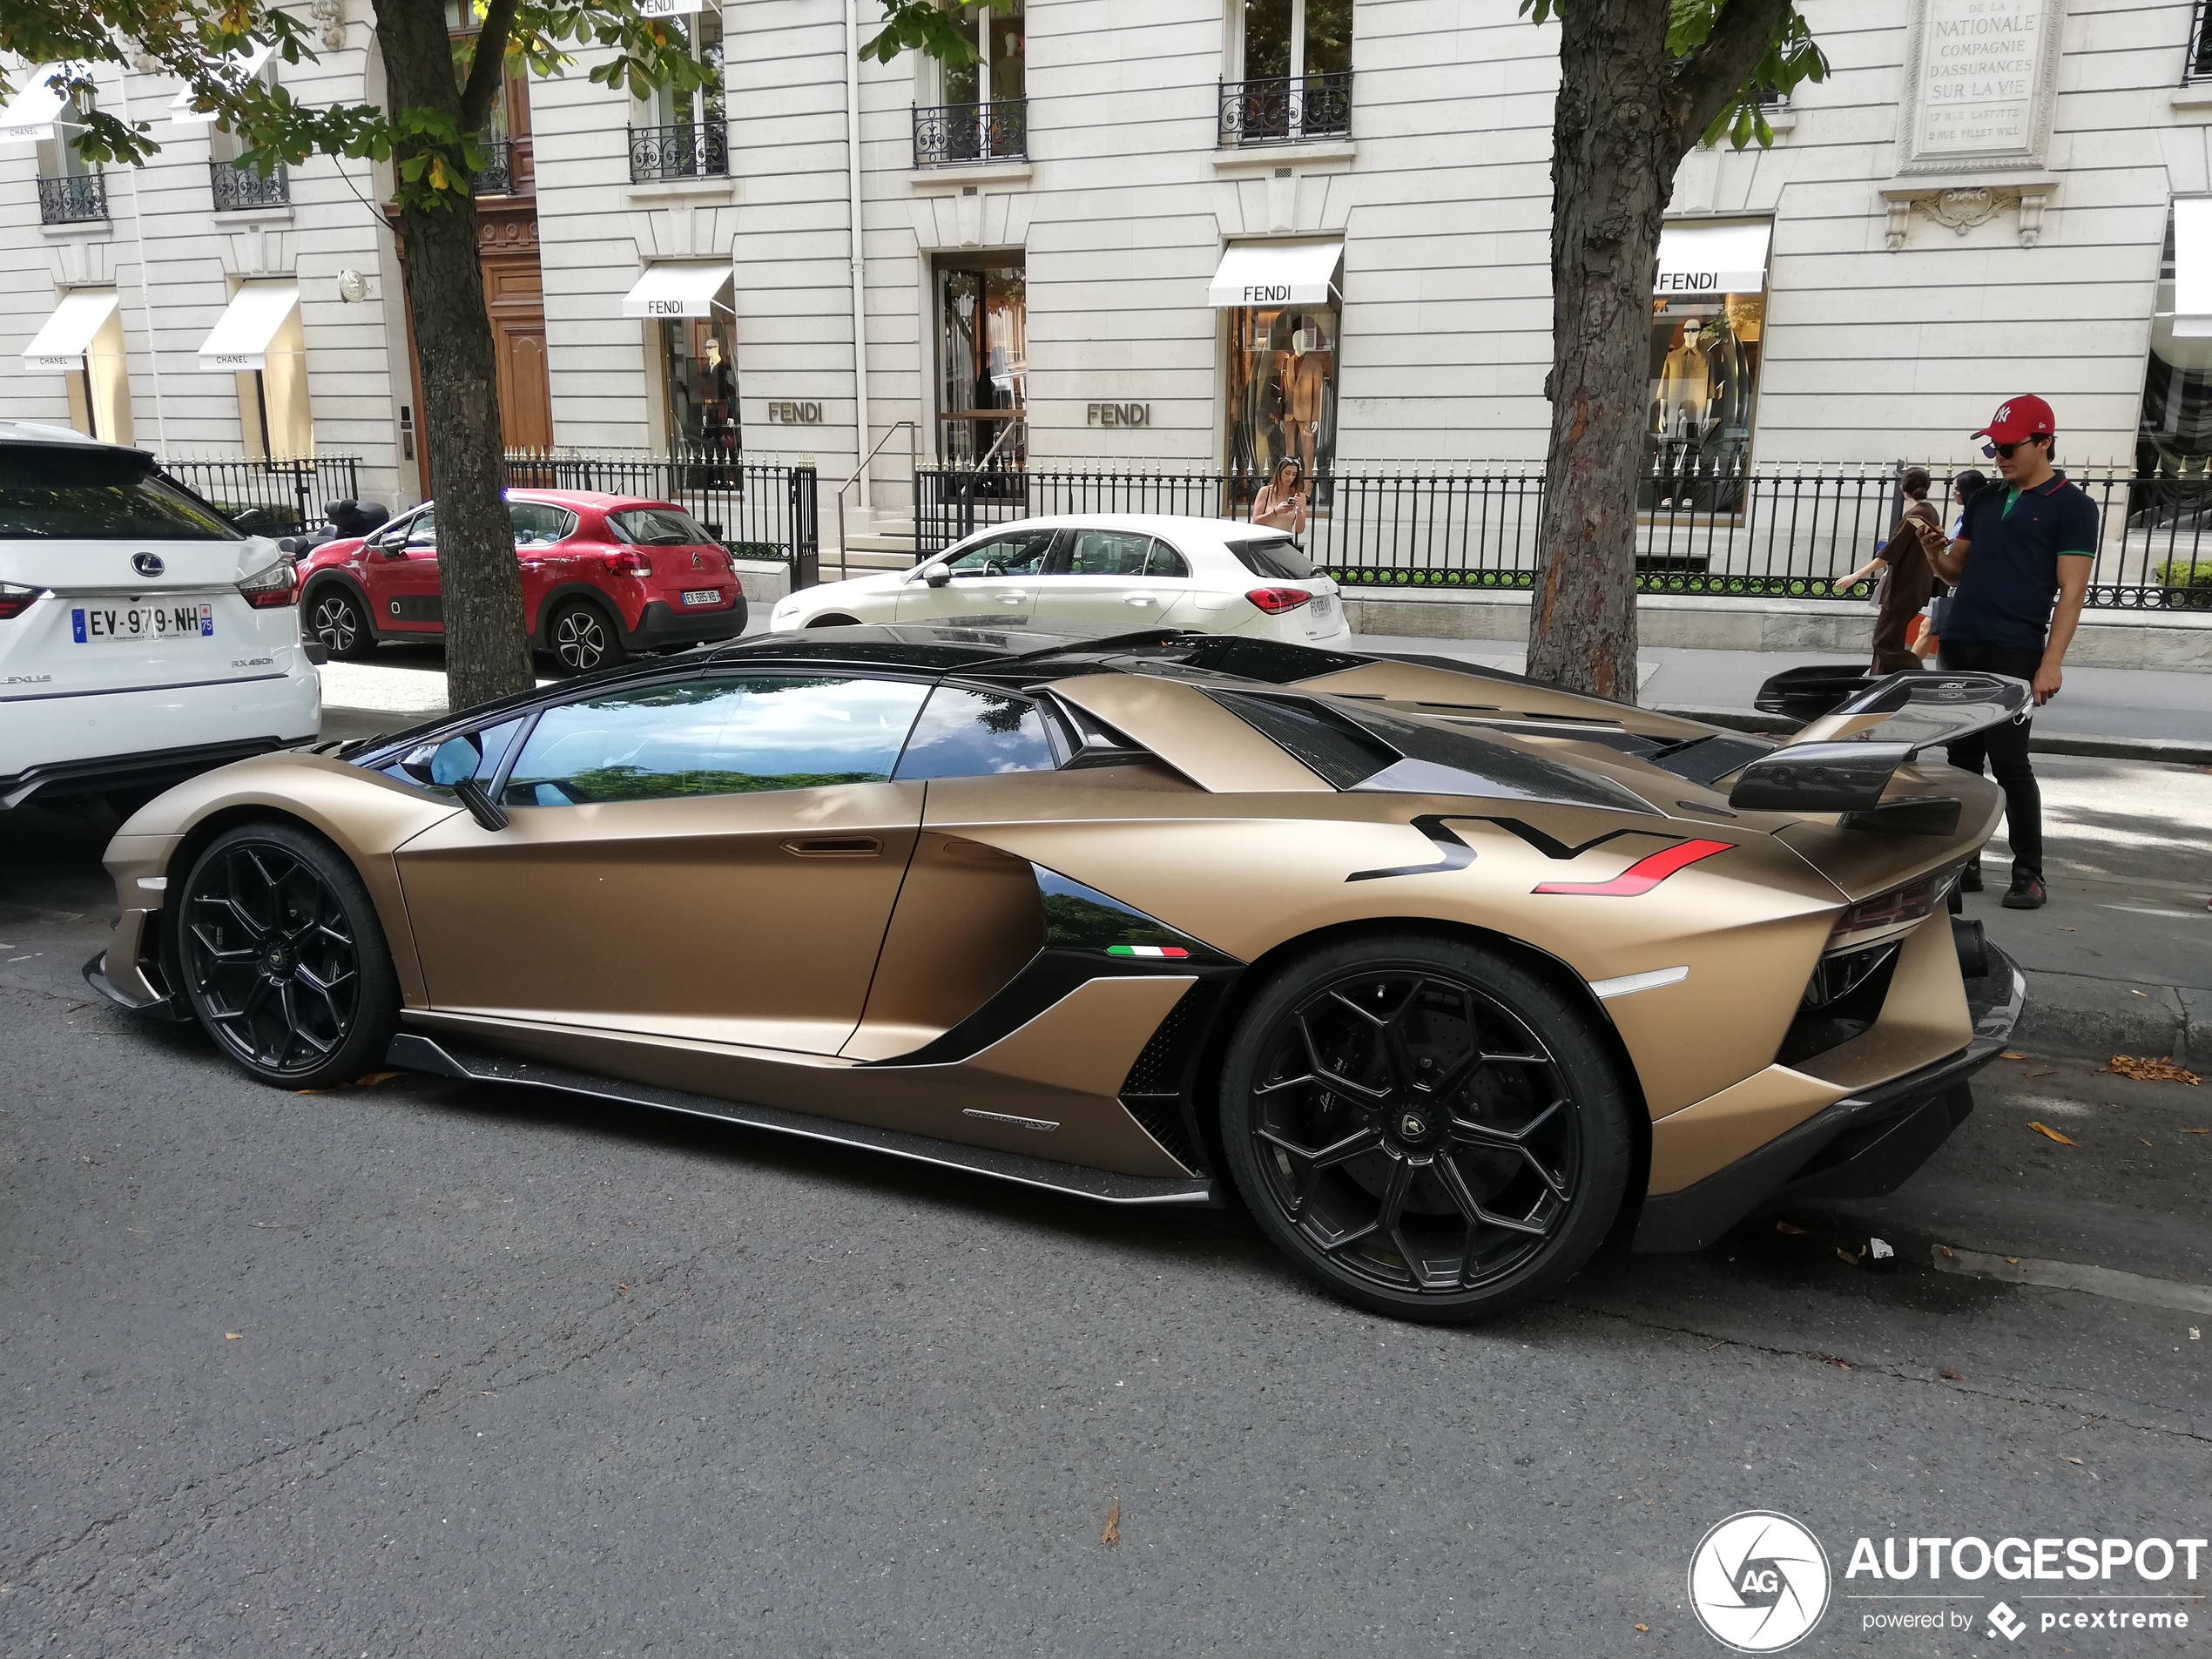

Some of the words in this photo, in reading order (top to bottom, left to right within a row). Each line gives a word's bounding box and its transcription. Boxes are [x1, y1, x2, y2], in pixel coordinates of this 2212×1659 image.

[646, 0, 675, 13] ENDI
[1969, 3, 1985, 14] DE
[1990, 3, 2006, 12] LA
[1935, 14, 2036, 37] NATIONALE
[1940, 39, 2026, 57] COMPAGNIE
[1930, 58, 2033, 78] D'ASSURANCES
[1932, 84, 1965, 99] SUR
[1972, 82, 1993, 97] LA
[1998, 79, 2026, 95] VIE
[1930, 112, 1941, 122] 17
[1945, 111, 1965, 121] RUE
[1971, 108, 2020, 120] LAFFITTE
[10, 126, 38, 137] CHANEL
[1928, 132, 1935, 140] 2
[1937, 131, 1956, 140] RUE
[1961, 128, 1993, 138] PILLET
[1997, 126, 2020, 137] WILL
[1659, 272, 1718, 290] FENDI
[1244, 285, 1291, 301] FENDI
[648, 300, 684, 314] FENDI
[216, 355, 248, 364] CHANEL
[768, 402, 823, 422] FENDI
[1087, 403, 1150, 425] FENDI
[90, 607, 199, 636] EV-979-NH
[201, 619, 212, 631] 75
[77, 626, 82, 635] F
[231, 659, 248, 669] RX
[248, 658, 273, 667] 450h
